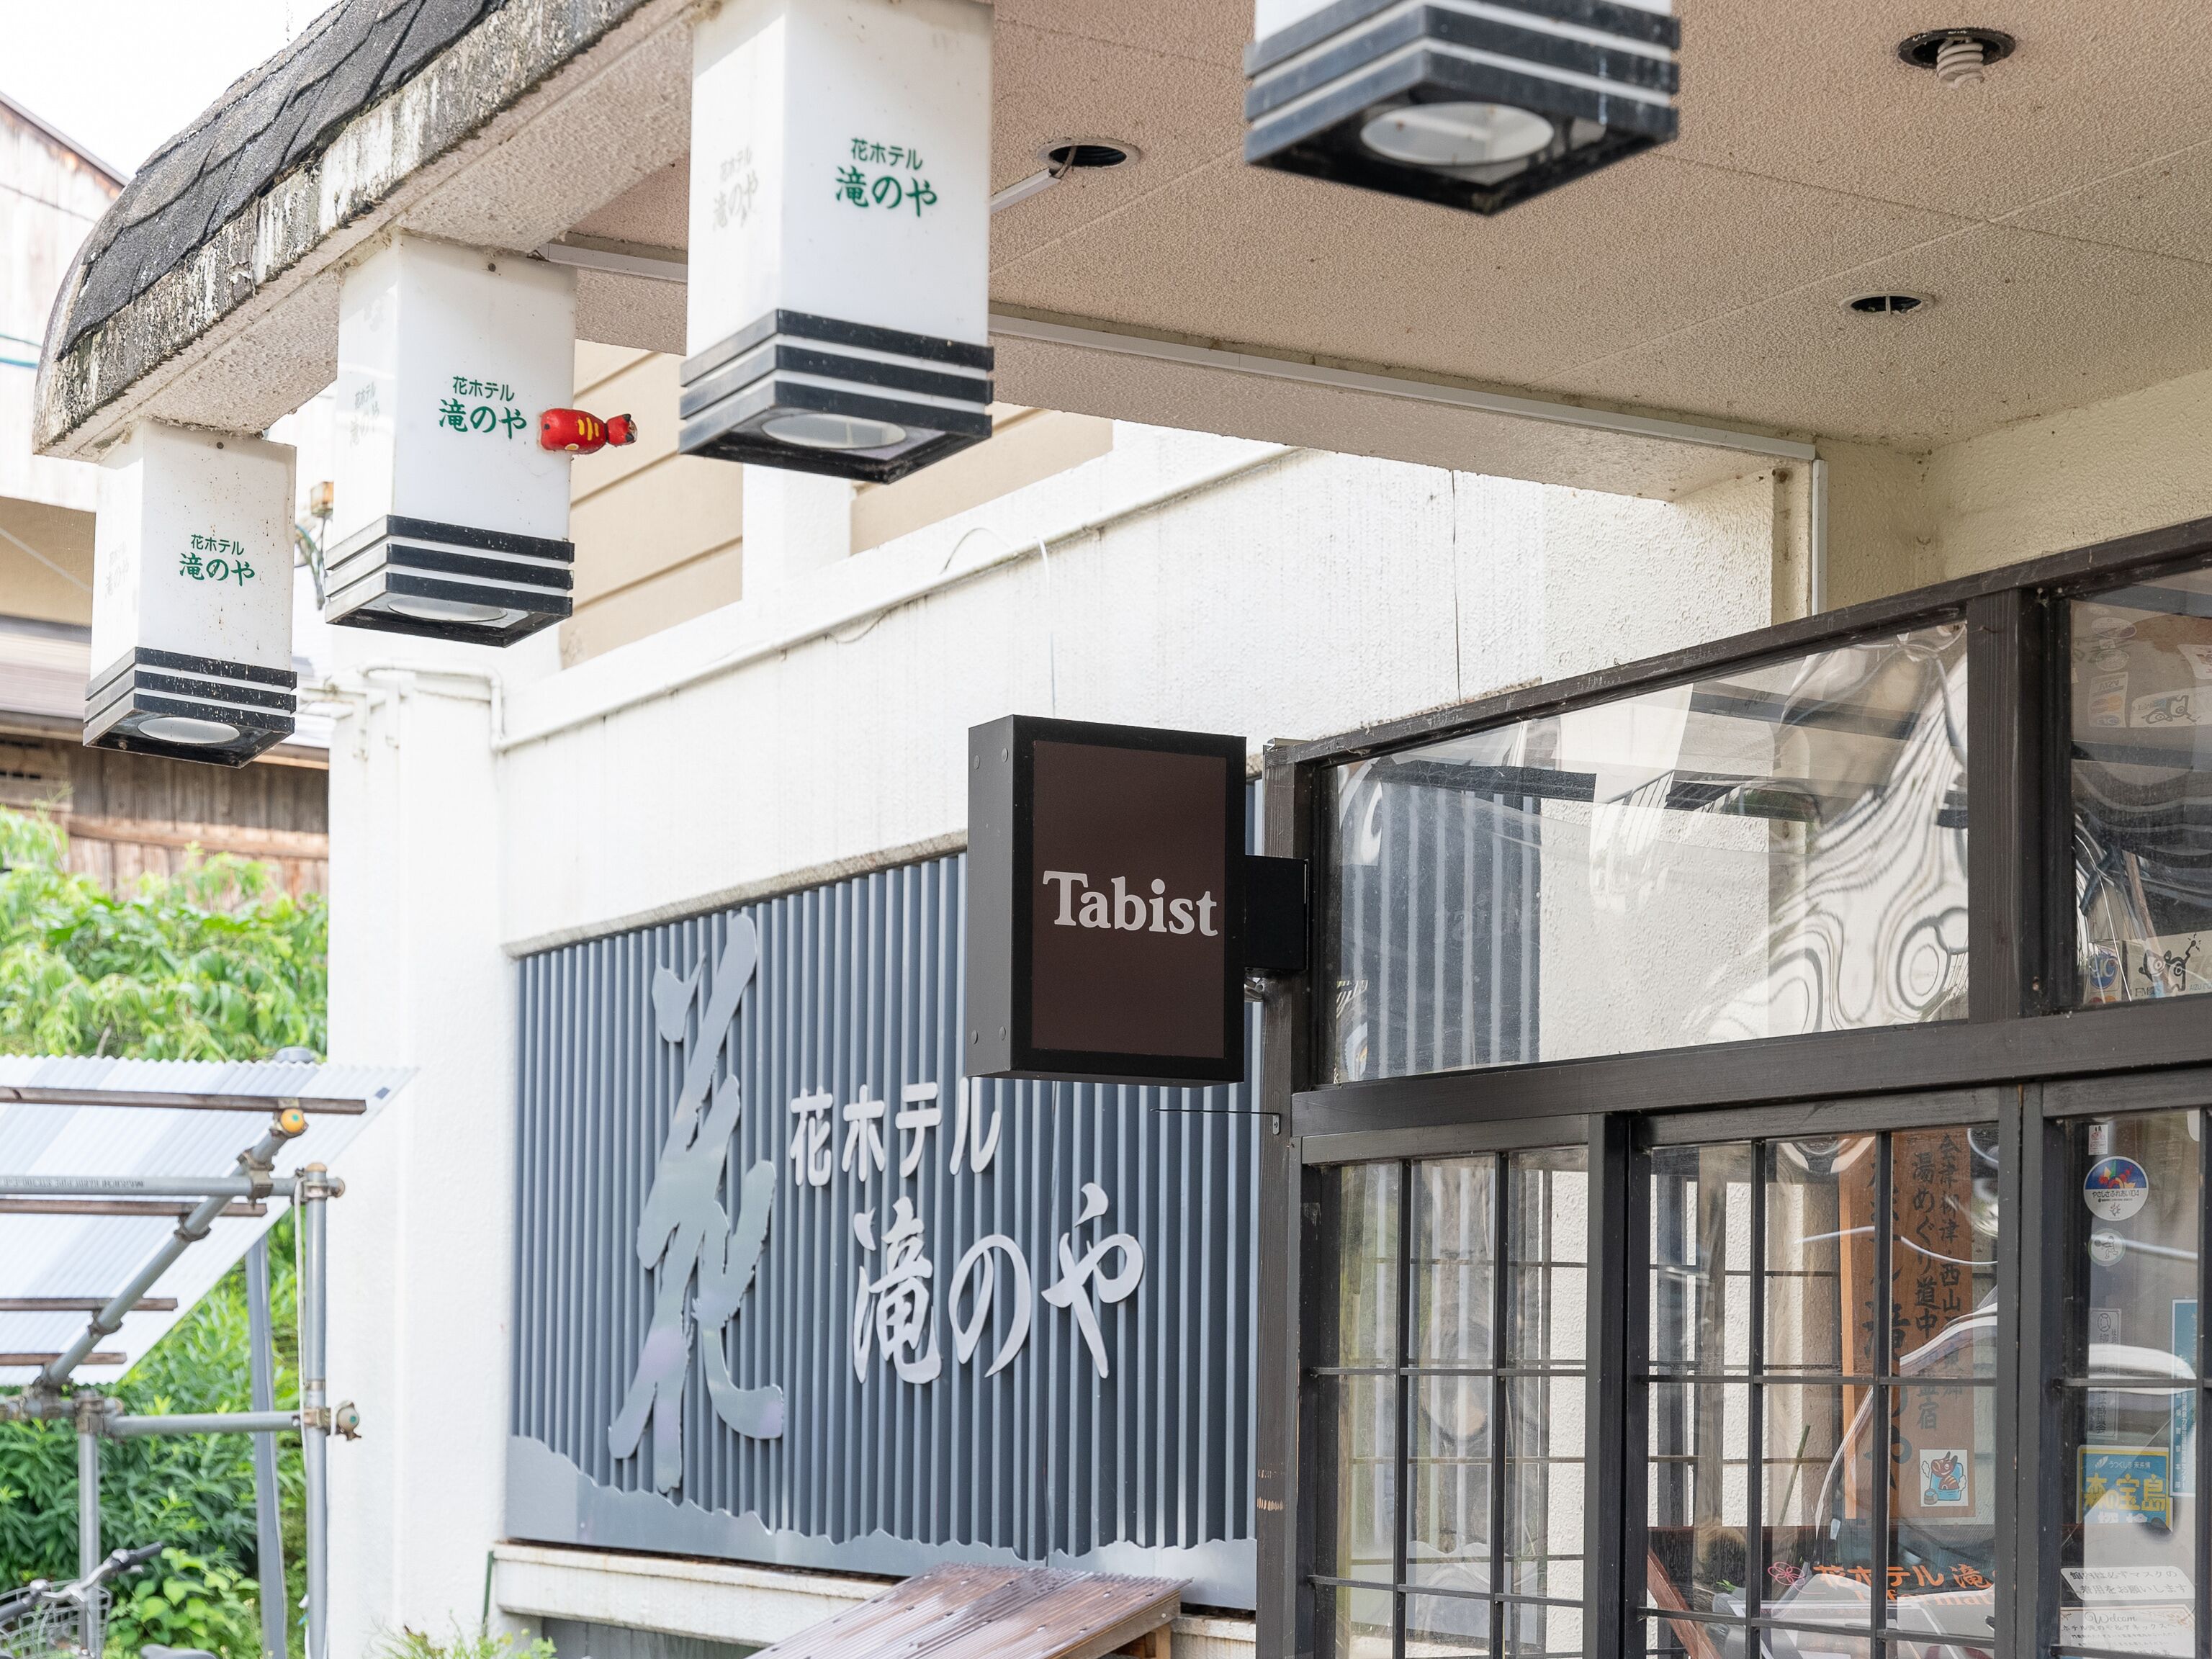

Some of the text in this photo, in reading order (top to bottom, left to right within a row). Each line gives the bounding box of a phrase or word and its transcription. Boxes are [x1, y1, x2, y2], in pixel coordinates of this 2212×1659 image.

[850, 138, 923, 171] 花ホテル
[835, 165, 938, 217] 滝のや
[452, 375, 515, 402] 花ホテル
[439, 397, 528, 440] 滝のや
[190, 534, 245, 556] 花ホテル
[179, 552, 256, 587] 滝のや
[1042, 870, 1219, 937] Tabist
[790, 1077, 1002, 1187] 花ホテル
[853, 1182, 1145, 1385] 滝のや
